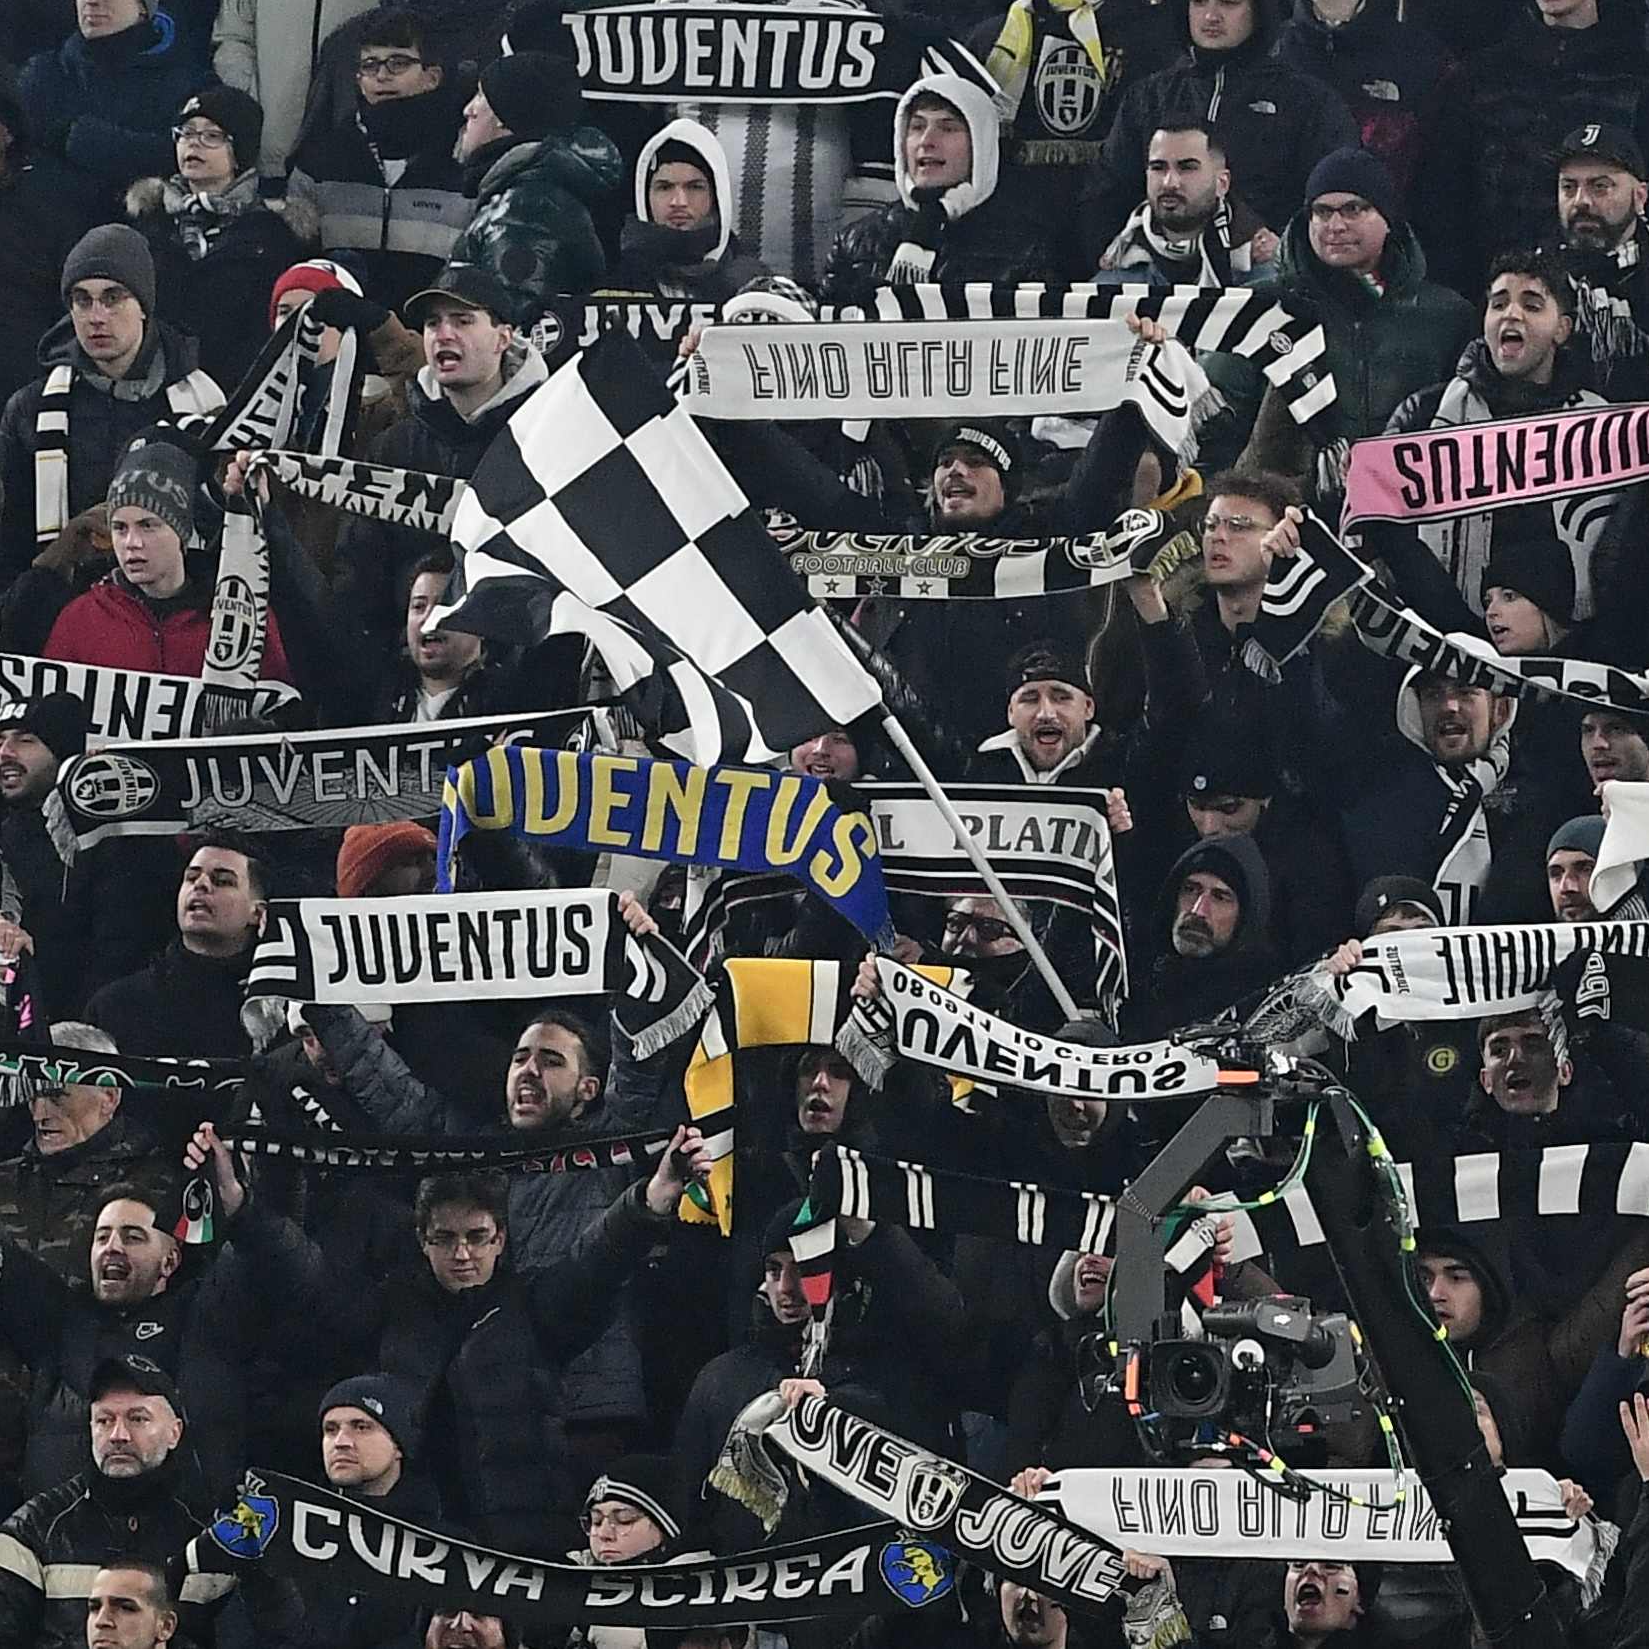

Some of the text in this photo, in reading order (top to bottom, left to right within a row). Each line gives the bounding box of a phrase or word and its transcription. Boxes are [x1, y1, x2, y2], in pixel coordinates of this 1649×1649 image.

[561, 14, 886, 90] JUVENTUS
[955, 425, 1014, 472] JUVENTUS
[790, 553, 972, 577] FOOTBALL CLUB
[180, 733, 462, 810] JUVENT
[456, 745, 878, 899] UVENTUS
[953, 813, 1112, 864] PLATIN
[319, 903, 594, 985] JUVENTUS
[788, 1393, 912, 1500] UVE
[291, 1496, 873, 1610] CURVA SCIREA
[954, 1491, 1130, 1606] JUVE
